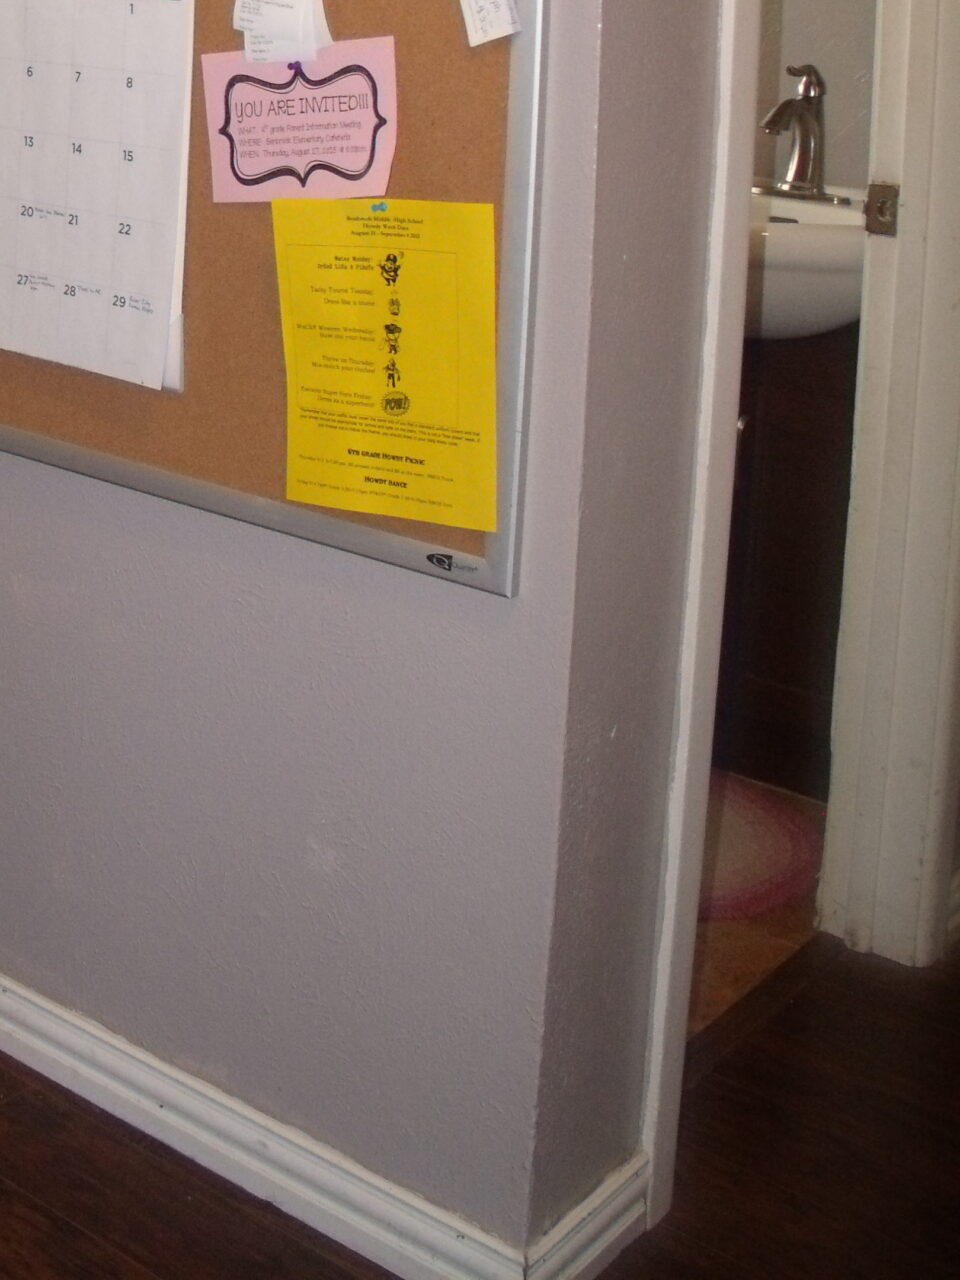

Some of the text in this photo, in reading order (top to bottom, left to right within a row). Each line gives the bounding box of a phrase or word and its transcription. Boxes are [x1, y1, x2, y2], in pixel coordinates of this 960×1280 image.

[129, 3, 134, 15] 1
[27, 66, 33, 77] 6
[75, 72, 81, 82] 7
[126, 77, 133, 88] 8
[235, 93, 369, 123] YOU ARE INVITED!!!
[305, 122, 339, 131] Information
[339, 120, 362, 130] Meeting
[24, 136, 34, 147] 13
[72, 143, 82, 154] 14
[123, 150, 134, 162] 15
[20, 205, 34, 217] 20
[68, 214, 78, 225] 21
[118, 222, 132, 235] 22
[16, 274, 29, 285] 27
[63, 284, 76, 297] 28
[112, 295, 126, 308] 29
[384, 395, 408, 411] POW!
[361, 450, 381, 460] GRADE
[382, 452, 404, 462] HOWDY
[405, 455, 425, 466] PICNIC
[364, 475, 387, 486] HOWDY
[387, 479, 408, 489] DANCE
